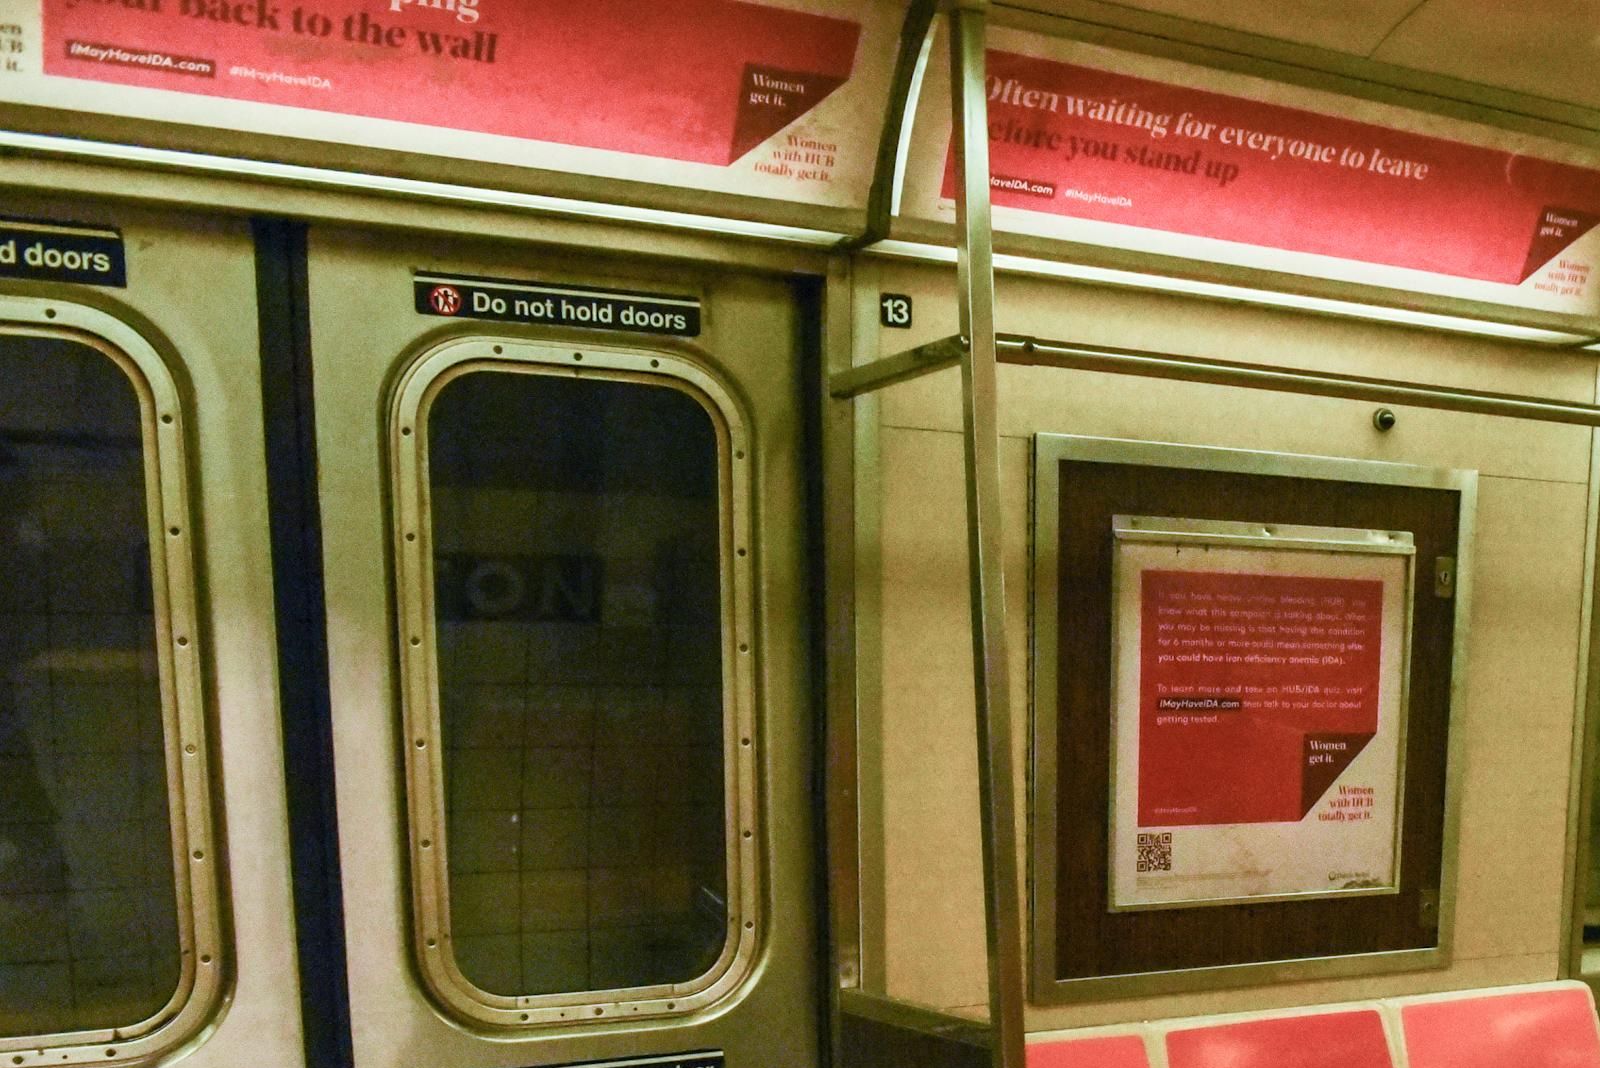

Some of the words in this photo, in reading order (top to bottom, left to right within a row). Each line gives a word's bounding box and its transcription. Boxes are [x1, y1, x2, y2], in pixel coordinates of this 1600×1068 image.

[292, 7, 332, 37] to
[344, 12, 406, 48] the
[418, 30, 498, 63] wall
[752, 73, 805, 94] Women
[749, 92, 769, 105] get
[787, 135, 838, 152] Women
[1066, 96, 1171, 138] waiting
[1175, 112, 1216, 140] for
[1219, 126, 1336, 163] everyone
[1340, 149, 1366, 168] to
[1368, 148, 1429, 180] leave
[773, 151, 801, 162] with
[1065, 135, 1118, 162] you
[1124, 144, 1201, 175] stand
[1204, 160, 1240, 187] up
[754, 162, 793, 177] totally
[797, 169, 818, 181] get
[990, 178, 1053, 195] aveIDA.com
[24, 242, 110, 273] doors
[472, 291, 507, 314] Do
[514, 300, 554, 319] not
[561, 300, 613, 323] hold
[620, 305, 687, 330] doors
[882, 299, 909, 324] 13
[1186, 607, 1207, 616] what
[1211, 608, 1226, 617] this
[1158, 623, 1174, 632] you
[1178, 624, 1196, 633] may
[1200, 623, 1210, 631] be
[1158, 655, 1174, 664] you
[1176, 653, 1200, 662] could
[1202, 654, 1223, 663] have
[1225, 654, 1242, 663] iron
[1157, 684, 1167, 693] To
[1171, 685, 1194, 693] learn
[1198, 686, 1221, 694] more
[1224, 685, 1241, 694] and
[1156, 715, 1189, 726] getting
[1310, 740, 1347, 751] Women
[1308, 754, 1323, 765] get
[1339, 785, 1374, 795] Women
[1329, 798, 1350, 809] with
[1318, 811, 1345, 822] totally
[1348, 812, 1362, 822] get
